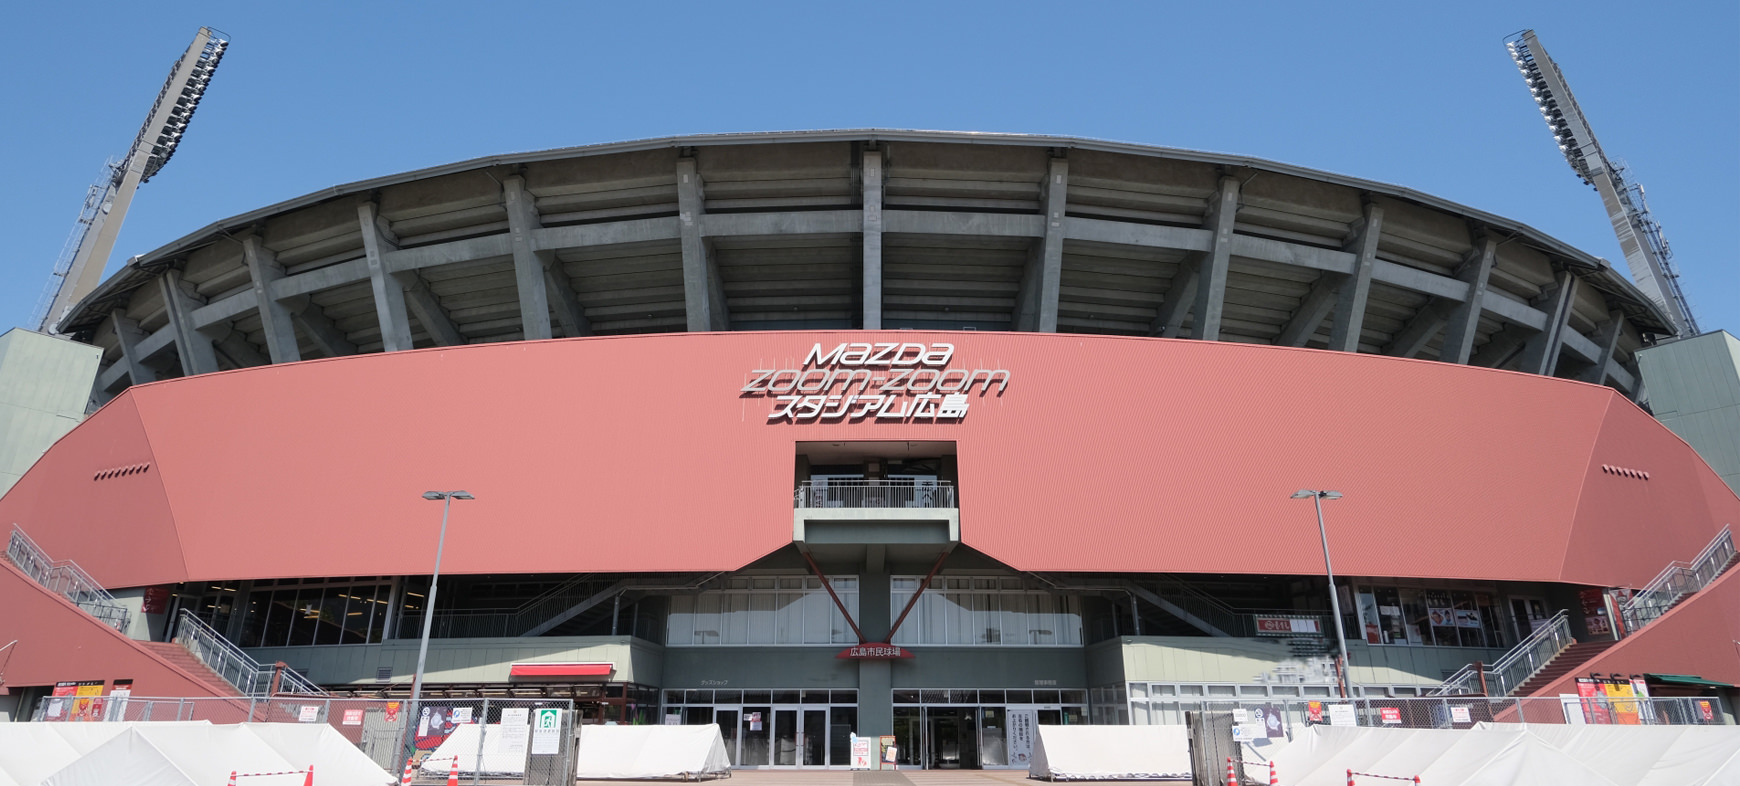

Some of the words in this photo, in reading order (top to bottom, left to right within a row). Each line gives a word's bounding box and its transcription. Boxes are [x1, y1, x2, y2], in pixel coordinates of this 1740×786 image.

[767, 393, 970, 418] スタジアム広島
[849, 646, 901, 657] 広島市民球場
